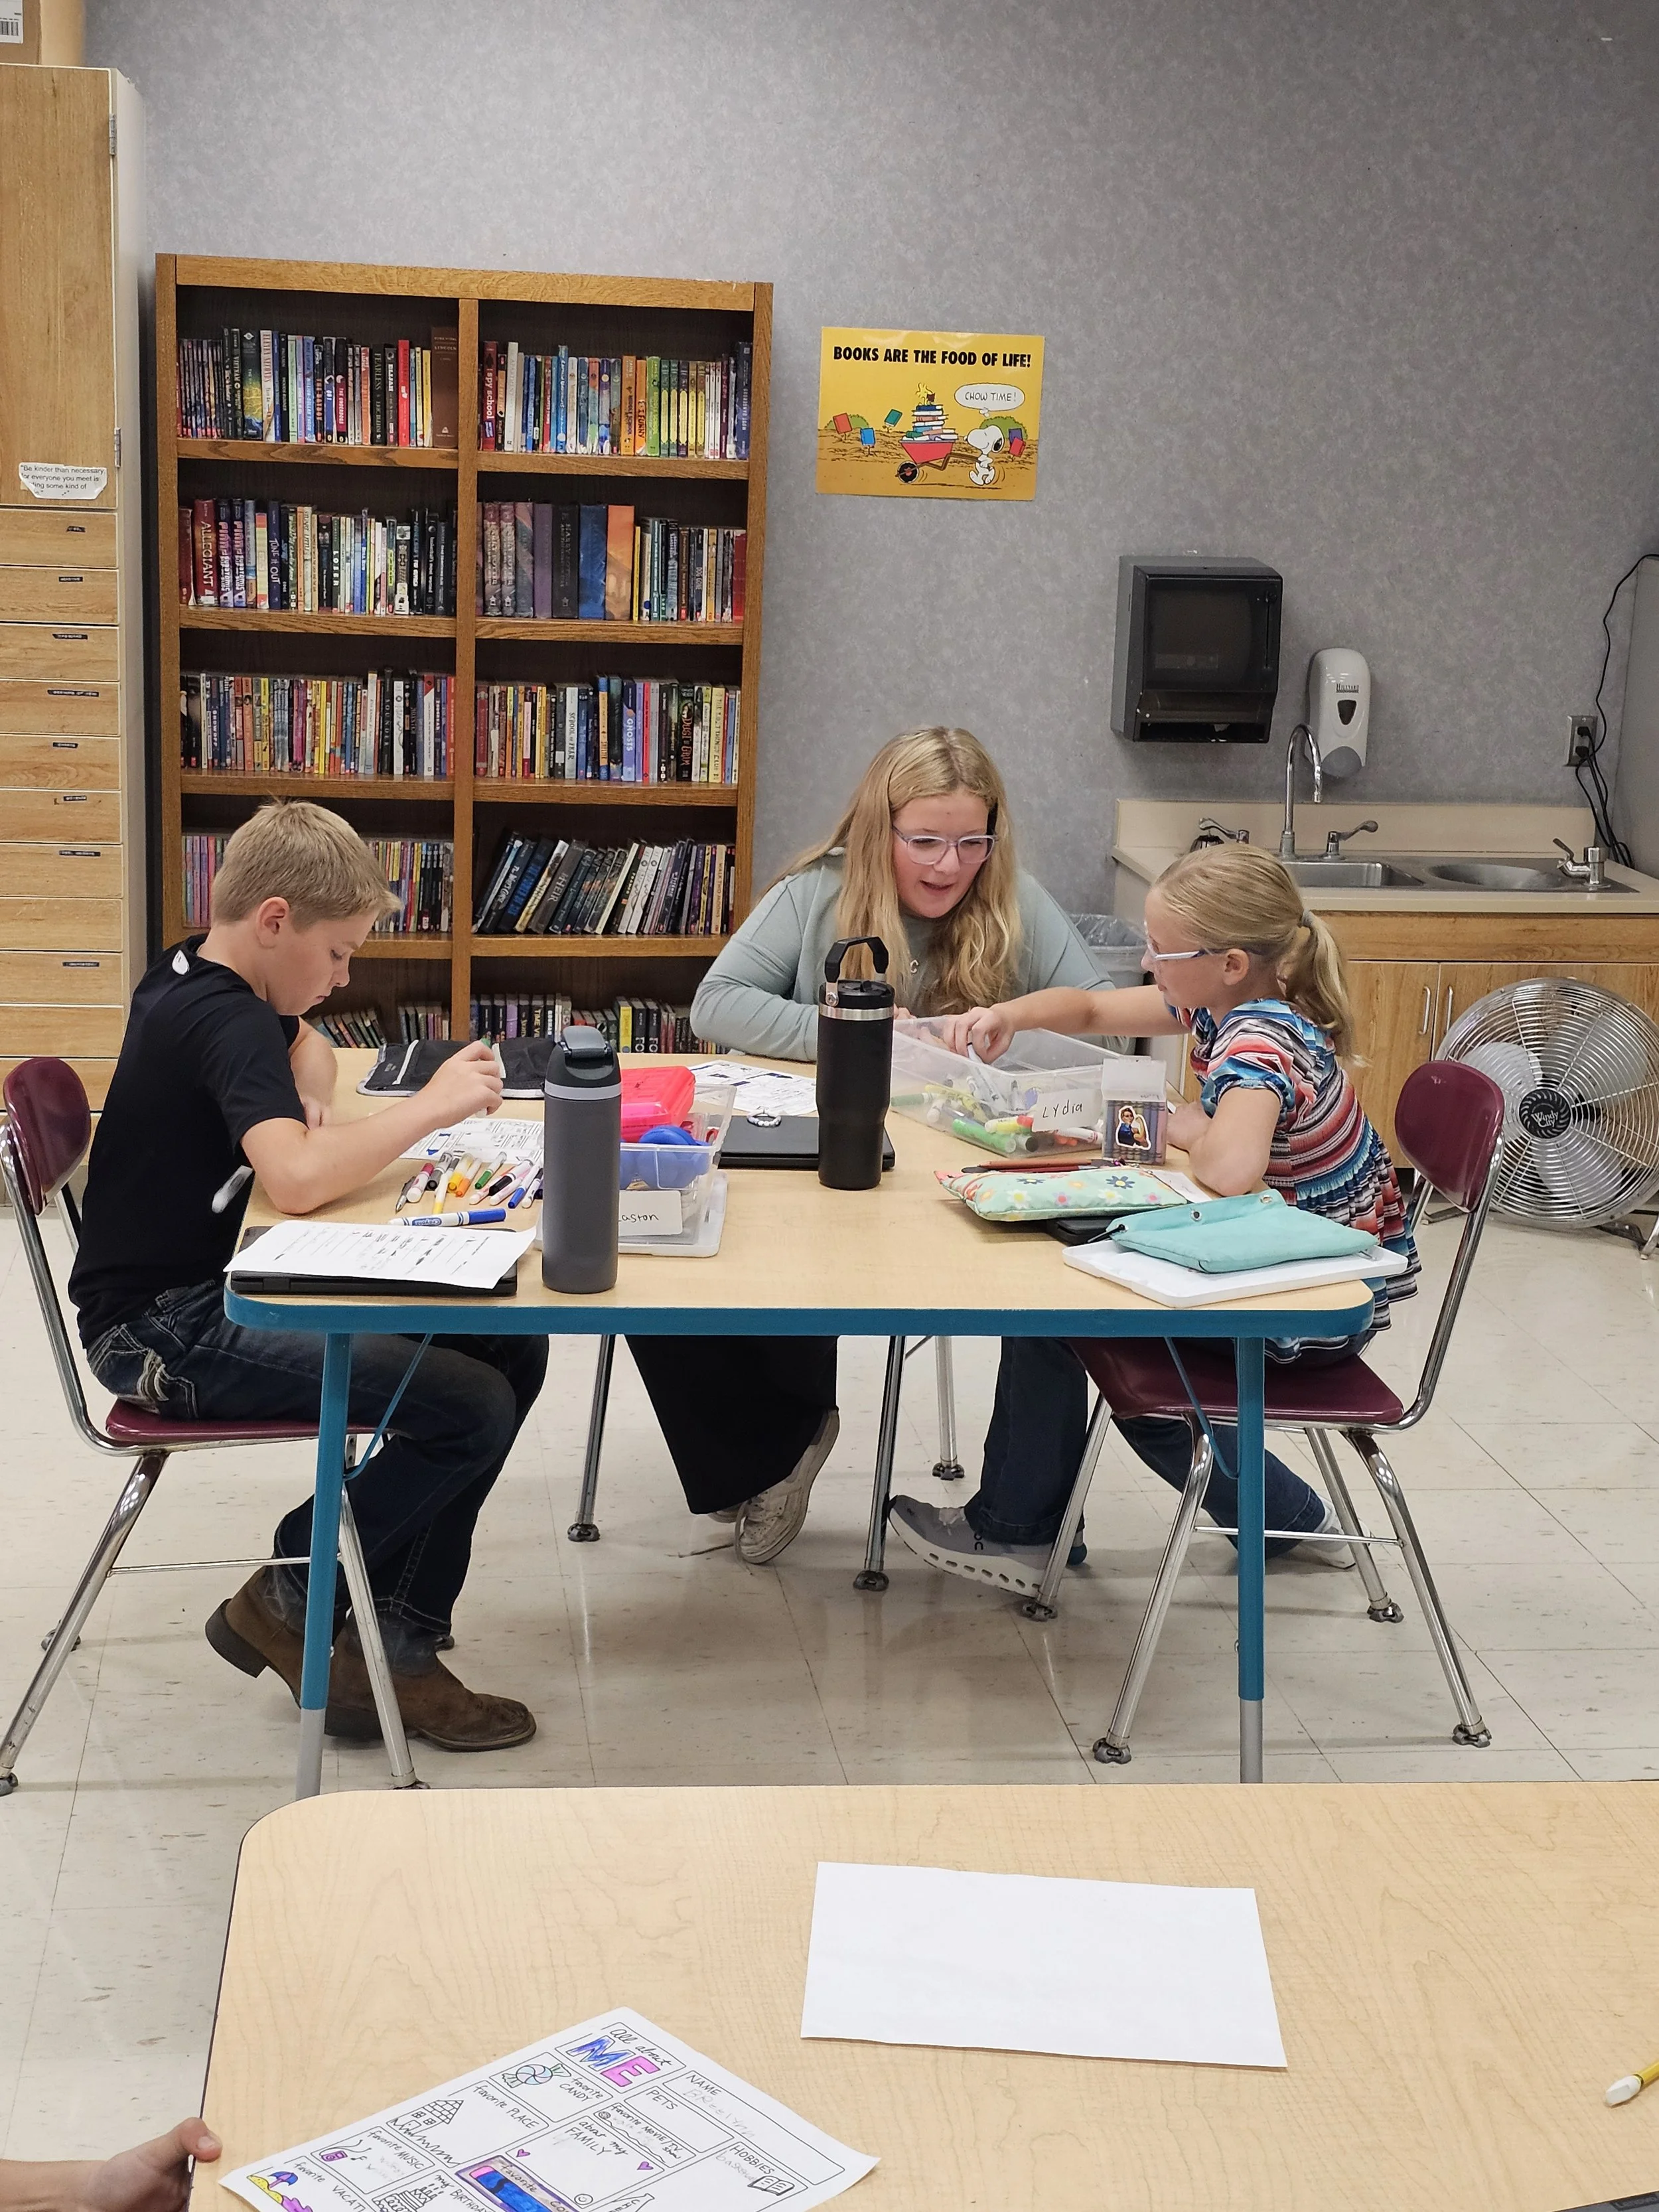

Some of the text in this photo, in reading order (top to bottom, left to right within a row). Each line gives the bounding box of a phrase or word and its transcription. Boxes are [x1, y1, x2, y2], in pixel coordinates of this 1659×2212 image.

[833, 346, 1031, 368] BOOKS ARE THE FOOD OF LIFE!
[965, 392, 987, 402] CHOW
[201, 521, 213, 587] ALLEGIANT
[269, 538, 279, 557] TUNE
[270, 567, 281, 584] OUT
[682, 717, 692, 740] DUST
[547, 877, 567, 902] HEIR
[1531, 1110, 1558, 1124] Windy
[1538, 1118, 1555, 1128] City
[618, 1214, 659, 1223] aston
[610, 2029, 672, 2066] All about
[565, 2035, 661, 2087] ME
[559, 2083, 594, 2102] CANDY
[571, 2077, 604, 2099] favorite
[686, 2075, 721, 2096] NAME
[472, 2085, 540, 2128] favorite PLACE
[646, 2089, 678, 2110] PETS
[611, 2104, 642, 2125] favorite
[565, 2126, 612, 2156] FAMILY
[579, 2121, 628, 2155] about my
[367, 2130, 425, 2170] favorite MUSIC
[729, 2145, 774, 2174] HOBBIES
[294, 2162, 326, 2183] favorite
[501, 2165, 538, 2193] favorite
[435, 2174, 488, 2212] my BIRTHDA
